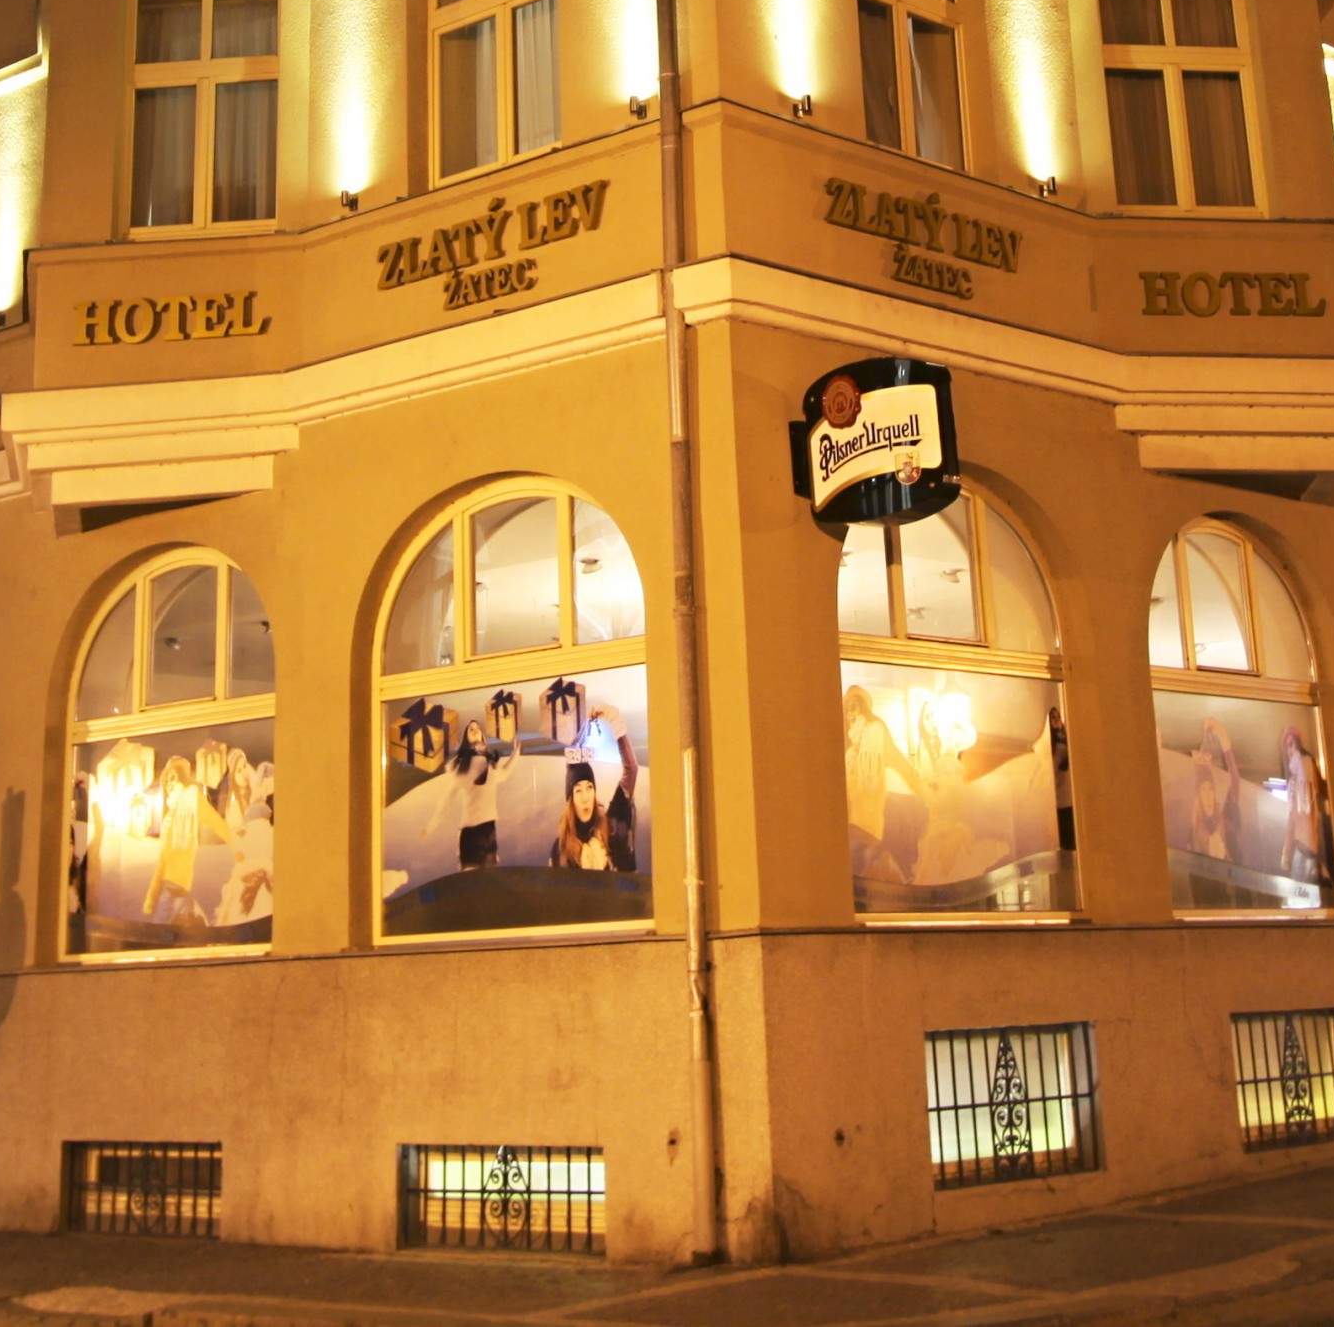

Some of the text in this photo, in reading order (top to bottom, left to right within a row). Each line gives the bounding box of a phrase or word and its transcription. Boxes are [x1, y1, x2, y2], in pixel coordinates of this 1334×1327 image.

[377, 179, 612, 291] ZLATÝ LEV
[823, 176, 1023, 274] ZLATÝ LEV
[443, 258, 540, 312] ŽATEC
[890, 242, 975, 301] ŽATEC
[1138, 271, 1327, 318] HOTEL
[71, 290, 273, 347] HOTEL
[819, 413, 921, 483] Pilsner Urquell
